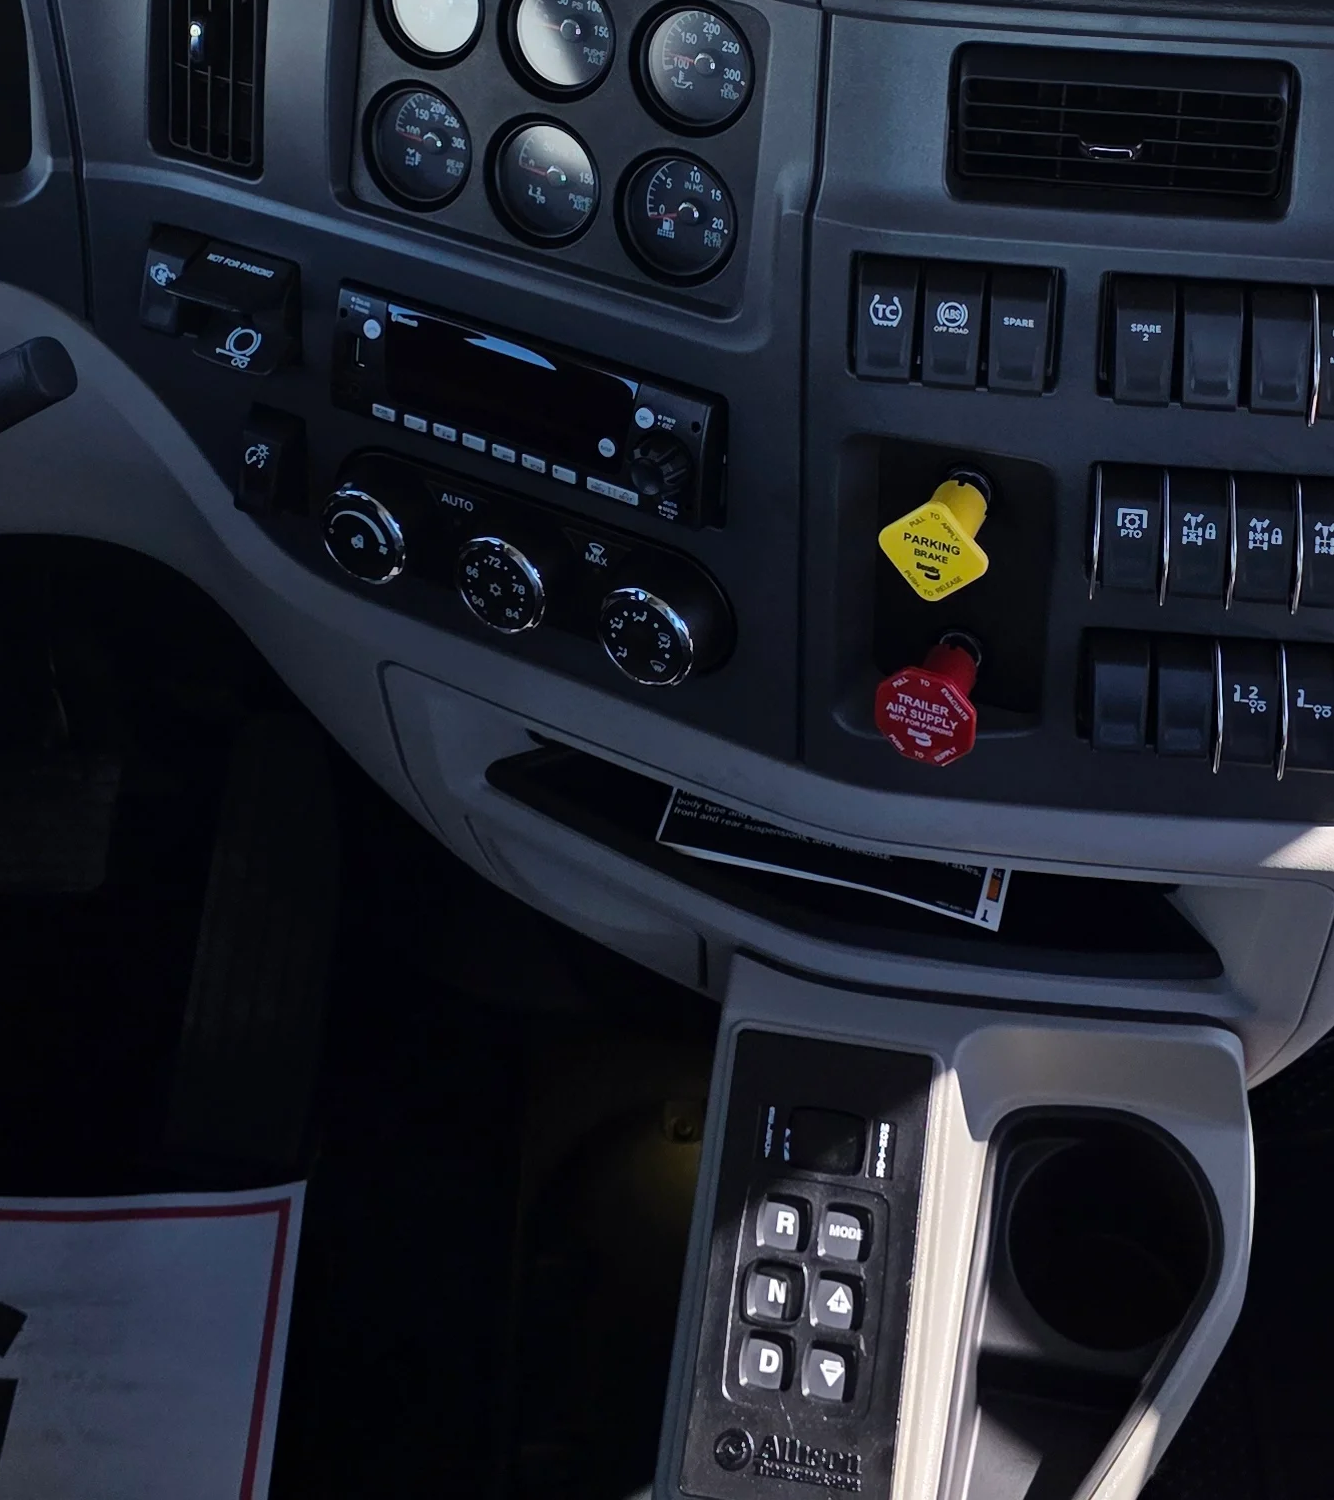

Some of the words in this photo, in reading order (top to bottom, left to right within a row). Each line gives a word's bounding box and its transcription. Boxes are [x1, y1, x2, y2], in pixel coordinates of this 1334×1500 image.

[571, 0, 584, 10] PSI
[703, 21, 720, 35] 200
[681, 32, 697, 44] 150
[722, 41, 740, 54] 250
[674, 57, 689, 69] 100
[723, 68, 741, 81] 300
[720, 88, 739, 100] TEMP
[414, 108, 429, 120] 150
[430, 102, 446, 115] 200
[406, 125, 421, 136] 100
[666, 177, 673, 189] 5
[690, 171, 701, 183] 10
[711, 188, 722, 201] 15
[659, 204, 665, 214] 0
[712, 217, 724, 230] 20
[704, 229, 721, 240] FUEL
[704, 238, 722, 249] FLTR
[223, 258, 240, 269] FOR
[874, 304, 897, 319] TC
[943, 308, 962, 321] ABS
[1003, 316, 1035, 328] SPARE
[1130, 323, 1162, 334] SPARE
[933, 325, 947, 333] OFF
[948, 326, 969, 335] ROAD
[1142, 333, 1149, 342] 2
[441, 493, 474, 512] AUTO
[909, 516, 925, 528] PULL
[930, 512, 940, 520] TO
[941, 522, 960, 542] APPLY
[1120, 528, 1142, 539] PTO
[903, 532, 961, 556] PARKING
[488, 555, 501, 569] 72
[585, 552, 608, 566] MAX
[914, 548, 948, 564] BRAKE
[465, 565, 479, 579] 66
[512, 583, 525, 595] 78
[905, 569, 920, 588] PUSH
[923, 589, 934, 597] TO
[935, 576, 963, 594] RELEASE
[471, 594, 485, 607] 60
[505, 608, 520, 620] 84
[897, 692, 949, 717] TRAILER
[920, 678, 930, 687] TO
[941, 687, 970, 721] EVACUATE
[886, 702, 907, 716] AIR
[909, 709, 958, 731] SUPPLY
[889, 713, 905, 723] NOT
[905, 718, 921, 728] FOR
[921, 722, 954, 738] PARKING
[914, 750, 924, 759] TO
[677, 797, 703, 810] body
[705, 804, 727, 816] type
[673, 805, 698, 818] front
[699, 813, 720, 825] and
[720, 818, 743, 828] rear
[776, 1211, 796, 1235] R
[829, 1224, 863, 1240] MODE
[767, 1279, 787, 1304] N
[759, 1348, 780, 1373] D
